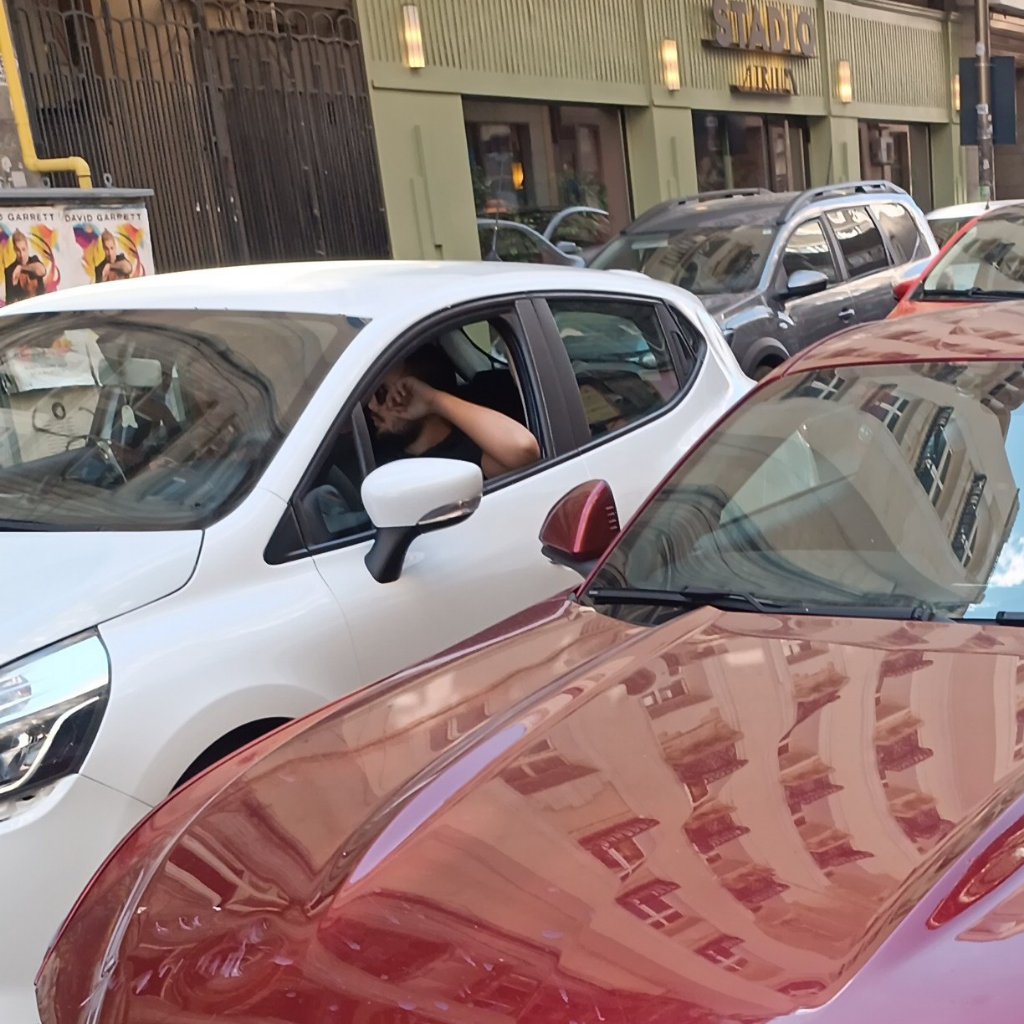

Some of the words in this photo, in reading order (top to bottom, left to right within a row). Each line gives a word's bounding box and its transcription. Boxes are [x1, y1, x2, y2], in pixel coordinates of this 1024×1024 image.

[713, 0, 816, 57] STADIO
[7, 213, 55, 221] GARRETT
[65, 213, 93, 223] DAVID
[96, 213, 142, 222] GARRETT
